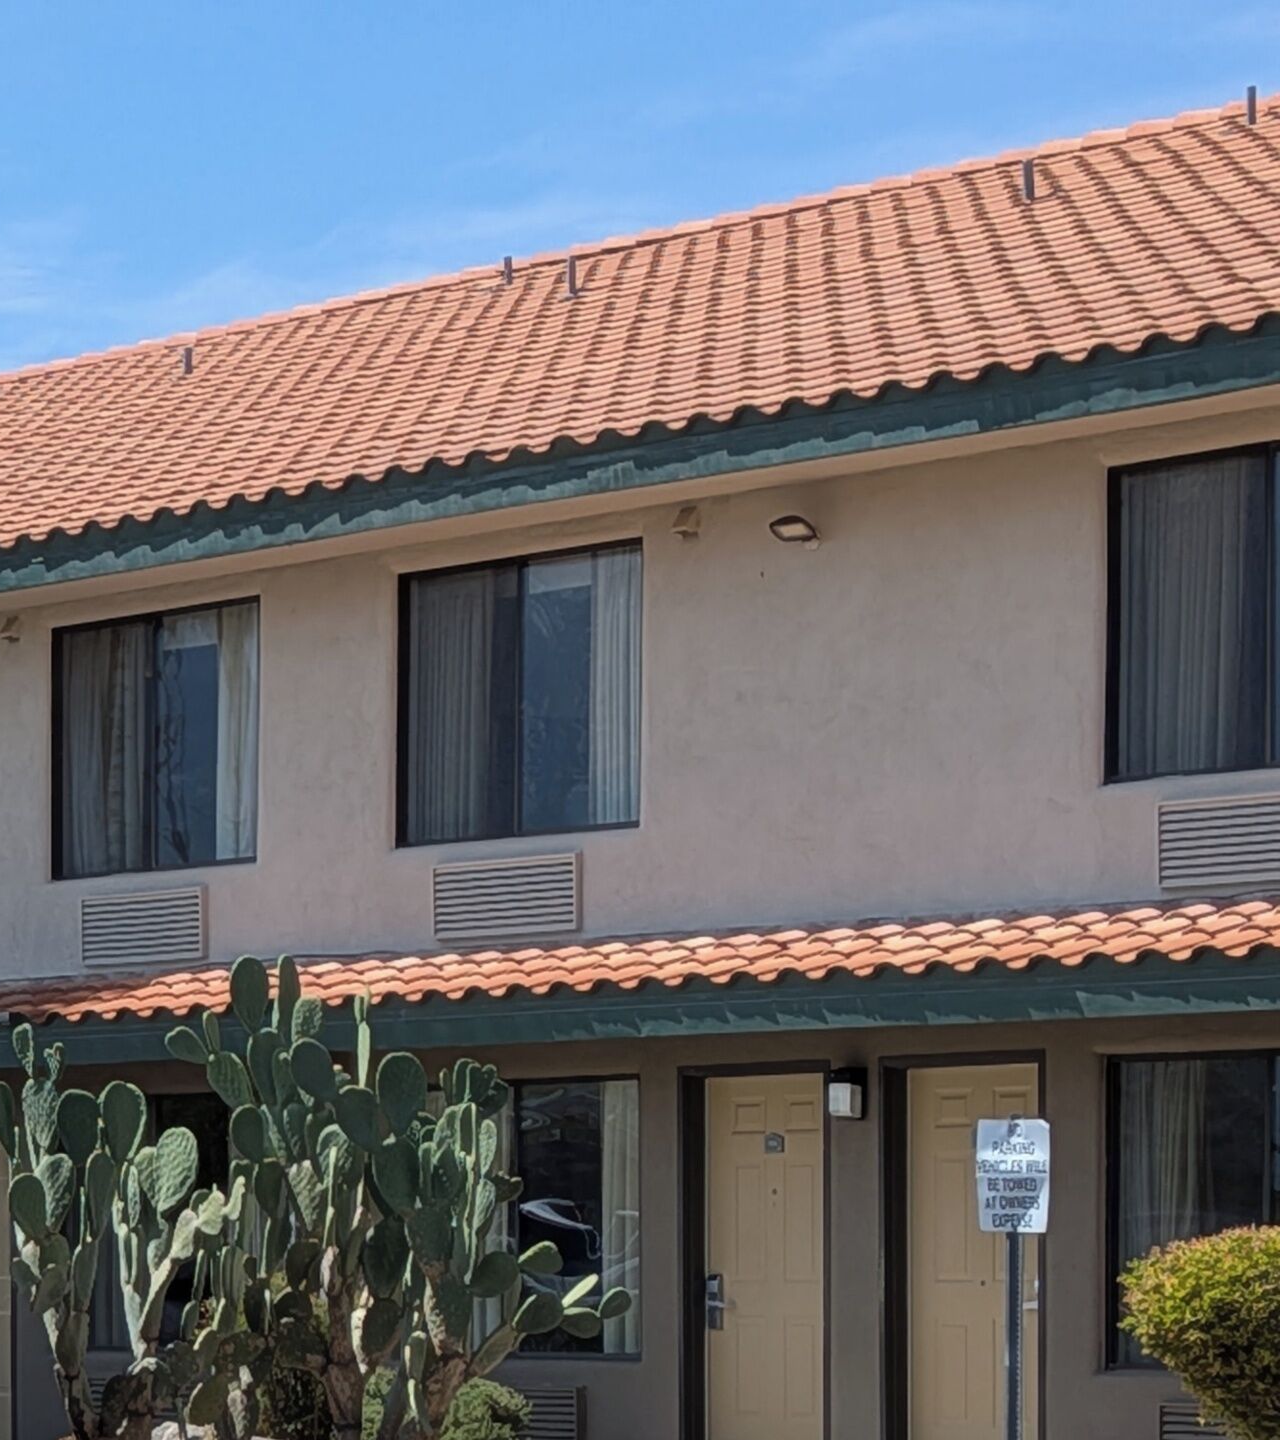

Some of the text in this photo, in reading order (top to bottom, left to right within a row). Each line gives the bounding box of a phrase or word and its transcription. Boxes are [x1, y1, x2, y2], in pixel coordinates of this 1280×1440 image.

[1007, 1122, 1022, 1138] NO
[992, 1141, 1035, 1155] PARKING
[976, 1159, 1048, 1174] VEHICLES WILL
[987, 1177, 1037, 1192] BE TOWED
[984, 1195, 998, 1209] AT
[991, 1212, 1032, 1228] EXPENSE
